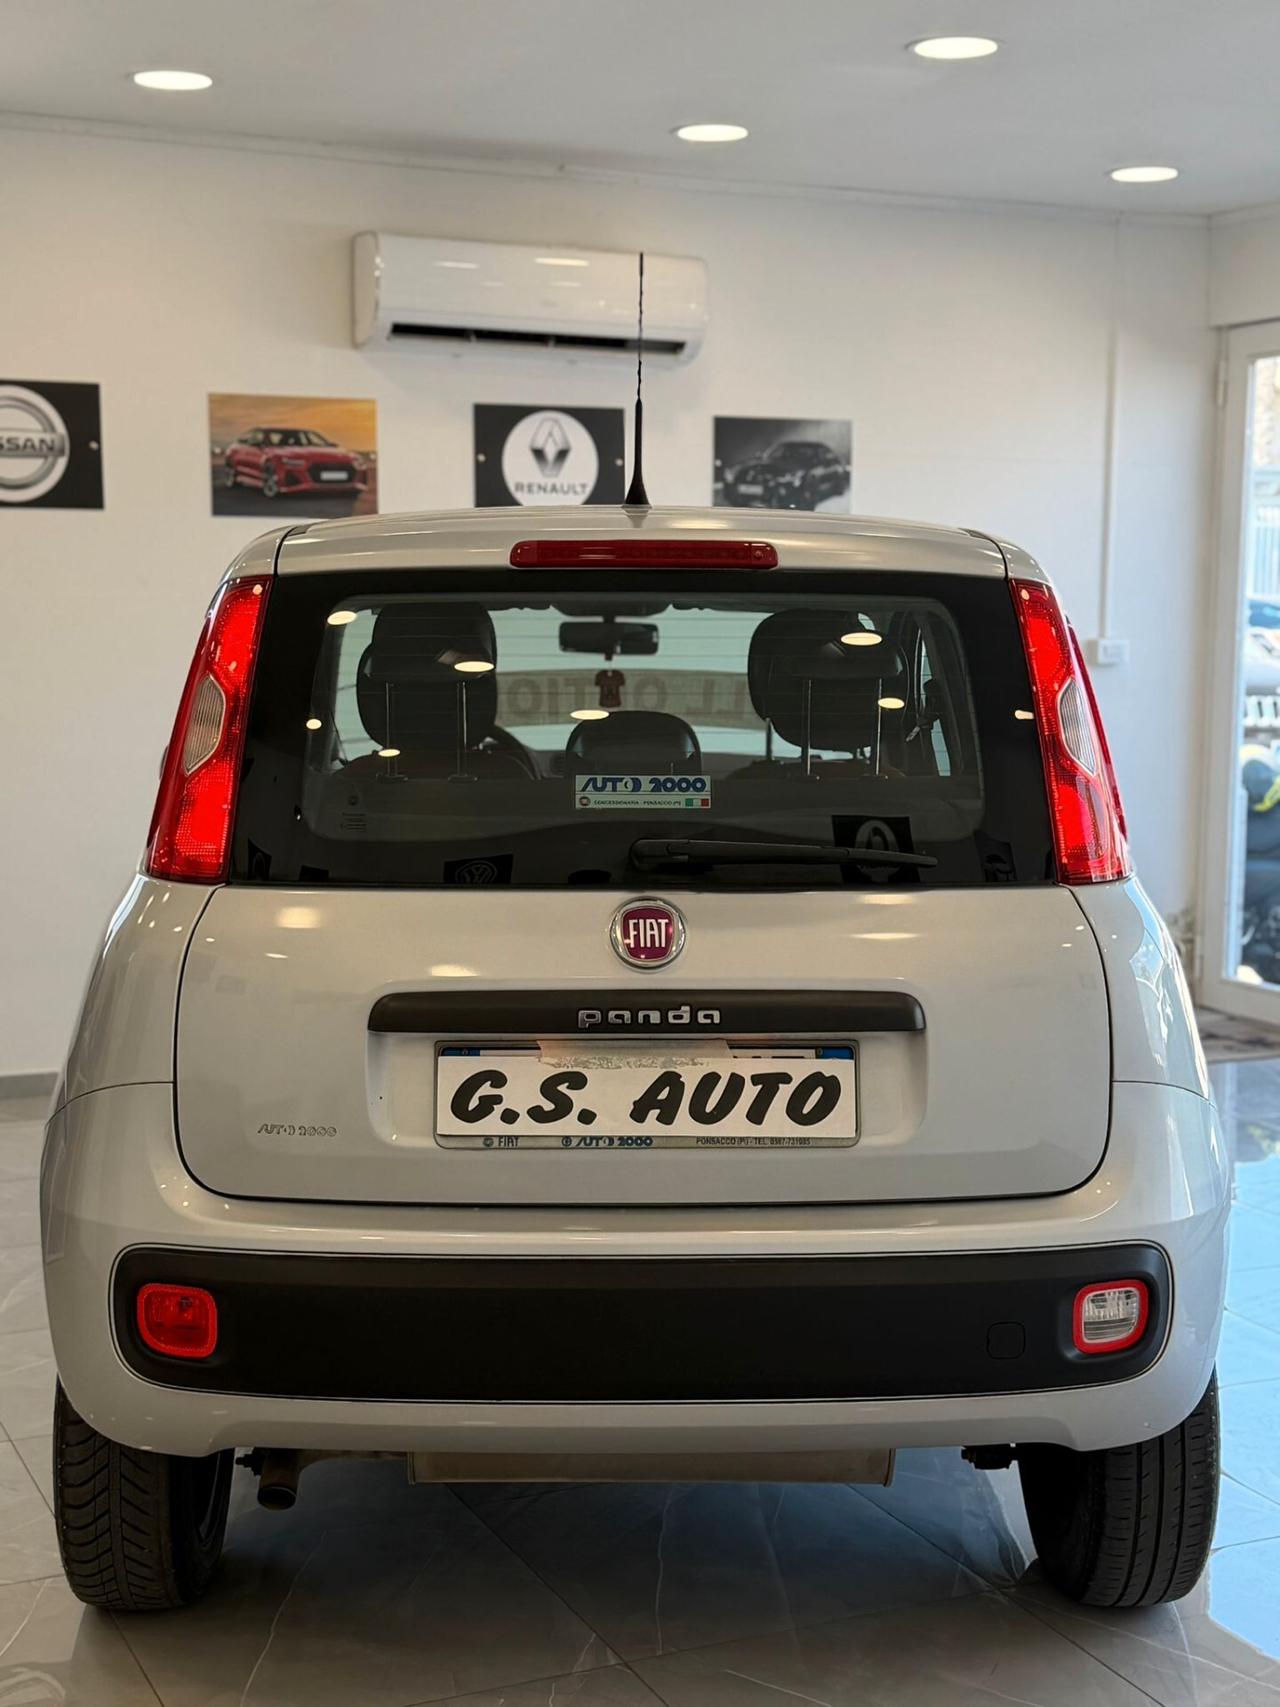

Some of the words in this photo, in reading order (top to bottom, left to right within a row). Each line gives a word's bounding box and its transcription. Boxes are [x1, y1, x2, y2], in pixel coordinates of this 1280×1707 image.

[514, 481, 589, 497] RENAULT
[580, 776, 642, 793] AUTO
[648, 776, 707, 793] 2000
[628, 918, 669, 949] FIAT
[577, 1004, 721, 1029] panda
[450, 1068, 598, 1126] G.S.
[629, 1070, 842, 1127] AUTO
[497, 1136, 520, 1147] FIAT
[575, 1136, 615, 1147] AUTO
[618, 1136, 654, 1147] 2000
